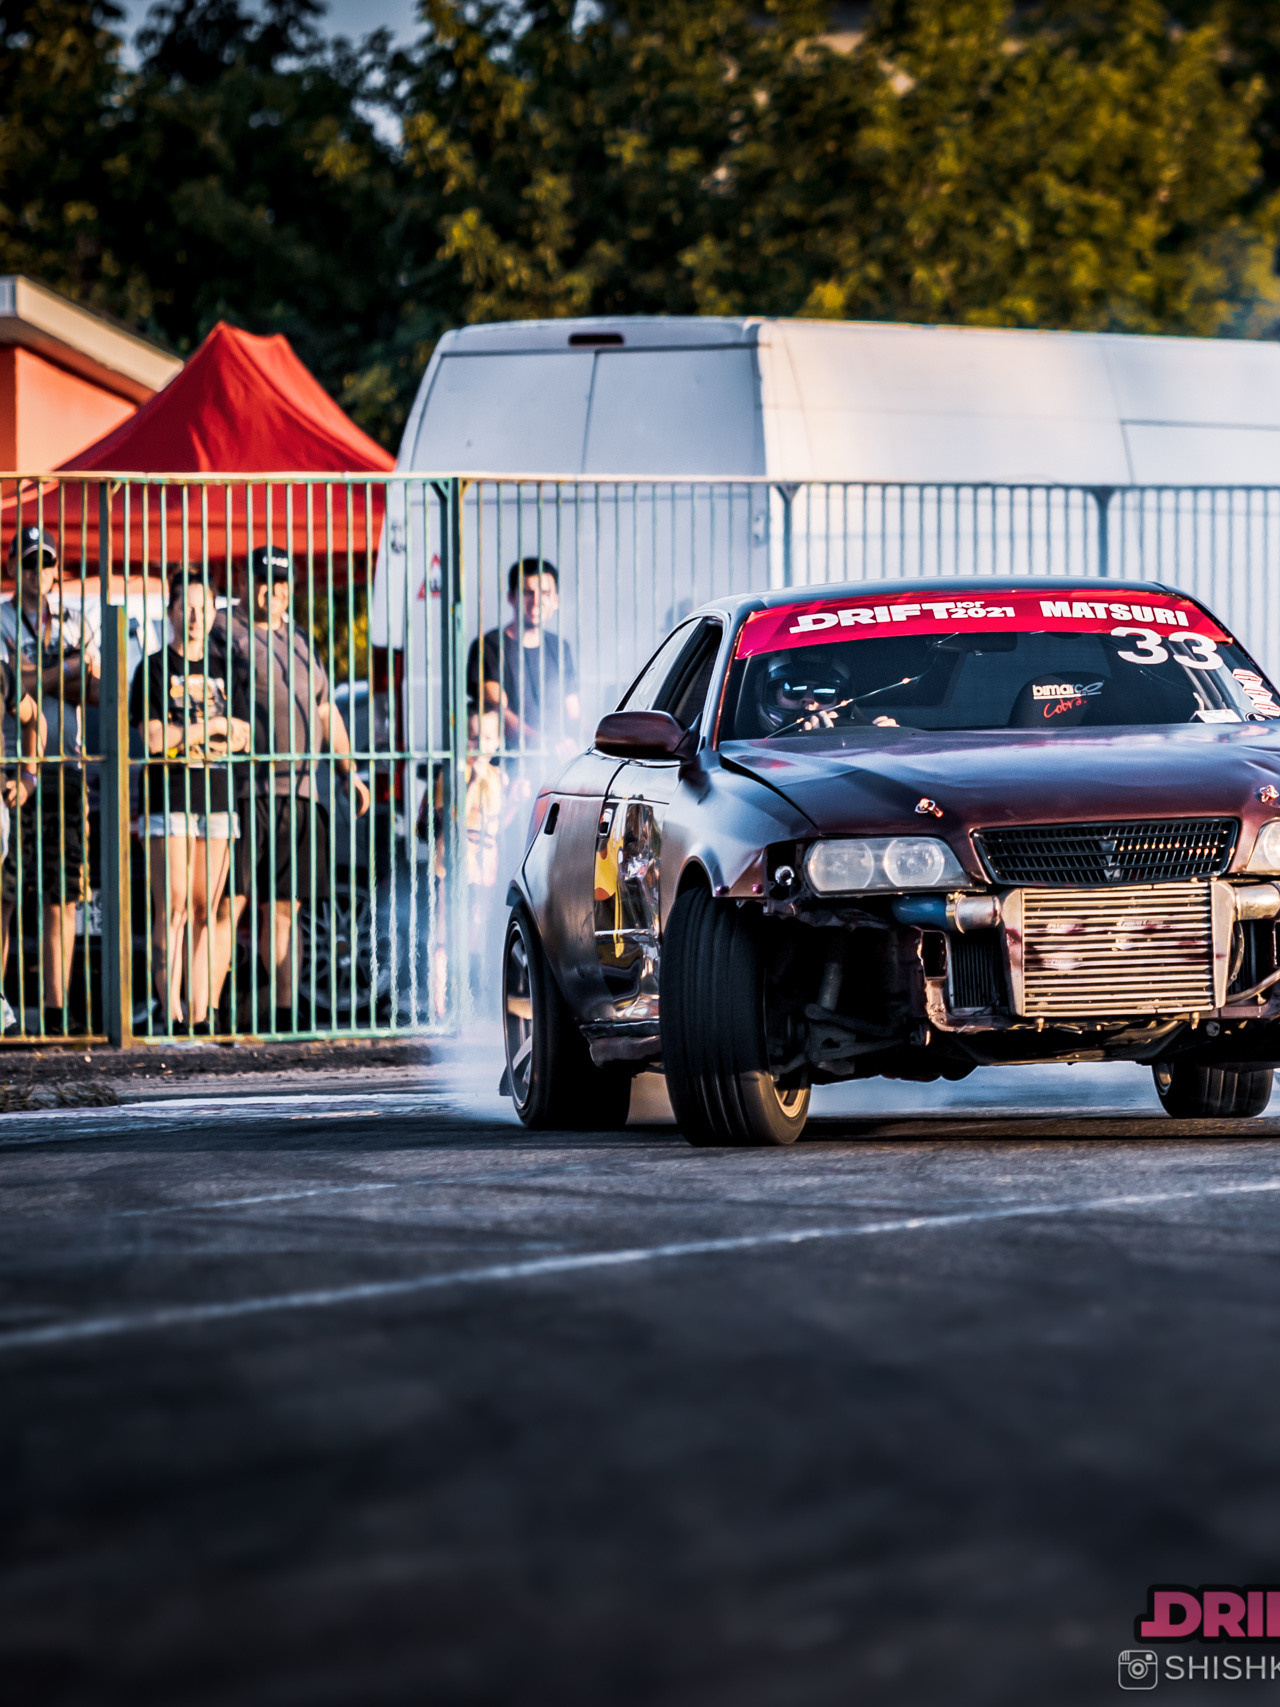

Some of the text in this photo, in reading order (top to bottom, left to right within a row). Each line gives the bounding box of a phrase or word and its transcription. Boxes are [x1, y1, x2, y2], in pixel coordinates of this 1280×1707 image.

[789, 602, 955, 634] DRIFT
[950, 607, 1016, 619] 2021
[1039, 601, 1190, 626] MATSURI
[1110, 626, 1224, 670] 33
